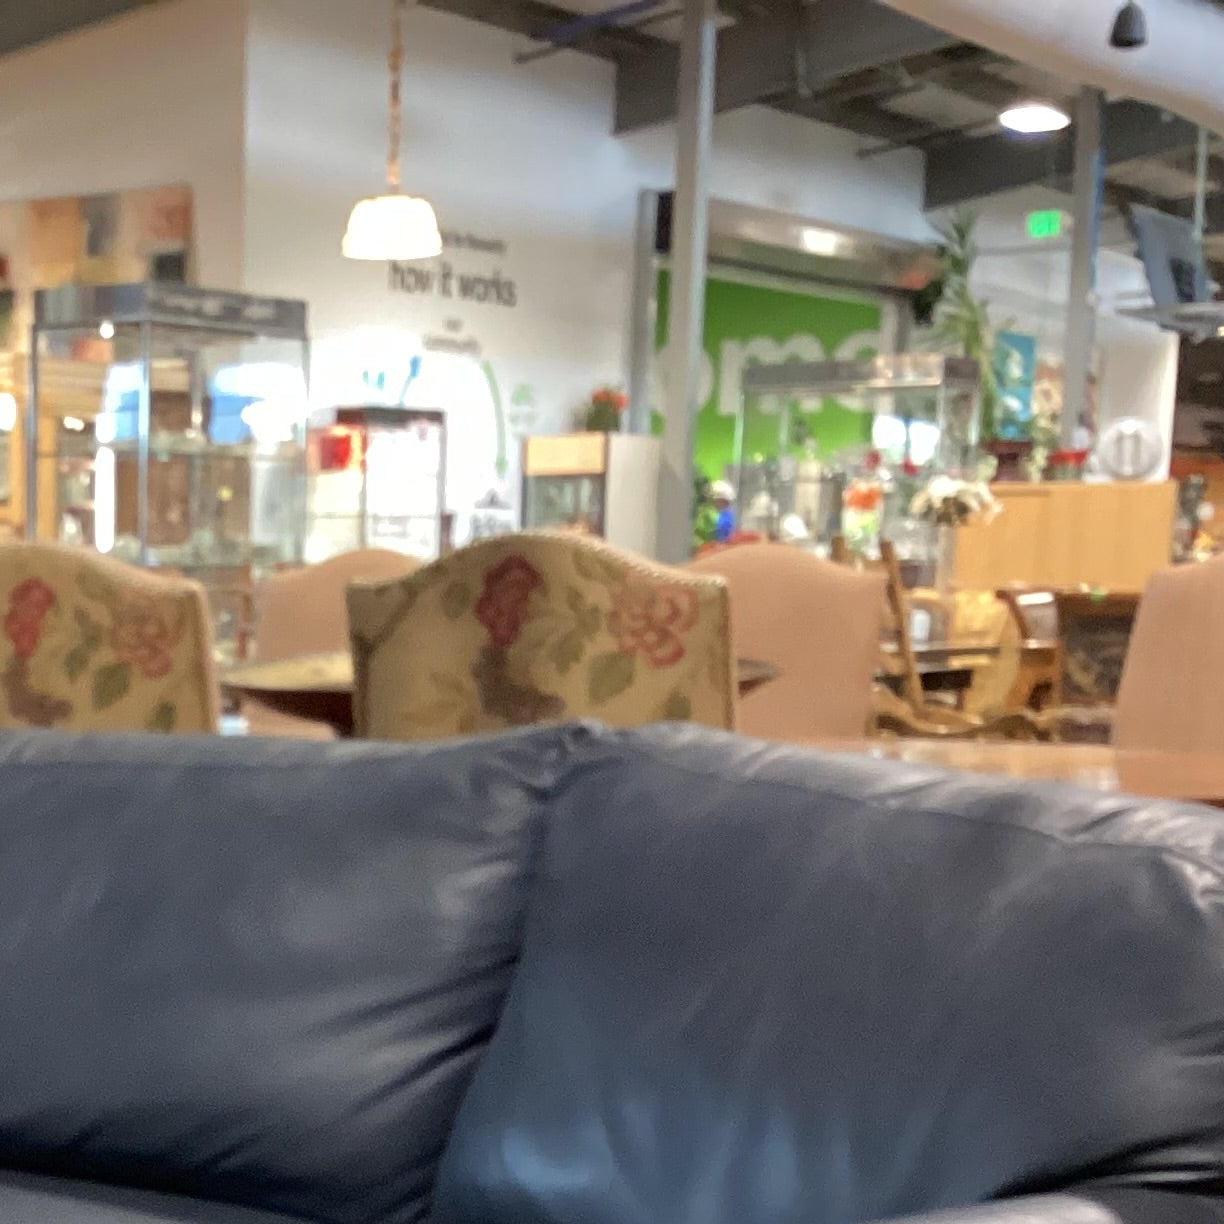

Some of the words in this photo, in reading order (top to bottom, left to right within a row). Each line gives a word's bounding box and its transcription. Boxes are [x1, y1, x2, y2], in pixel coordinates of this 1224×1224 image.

[388, 260, 432, 293] how
[439, 262, 453, 298] it
[457, 267, 517, 307] works
